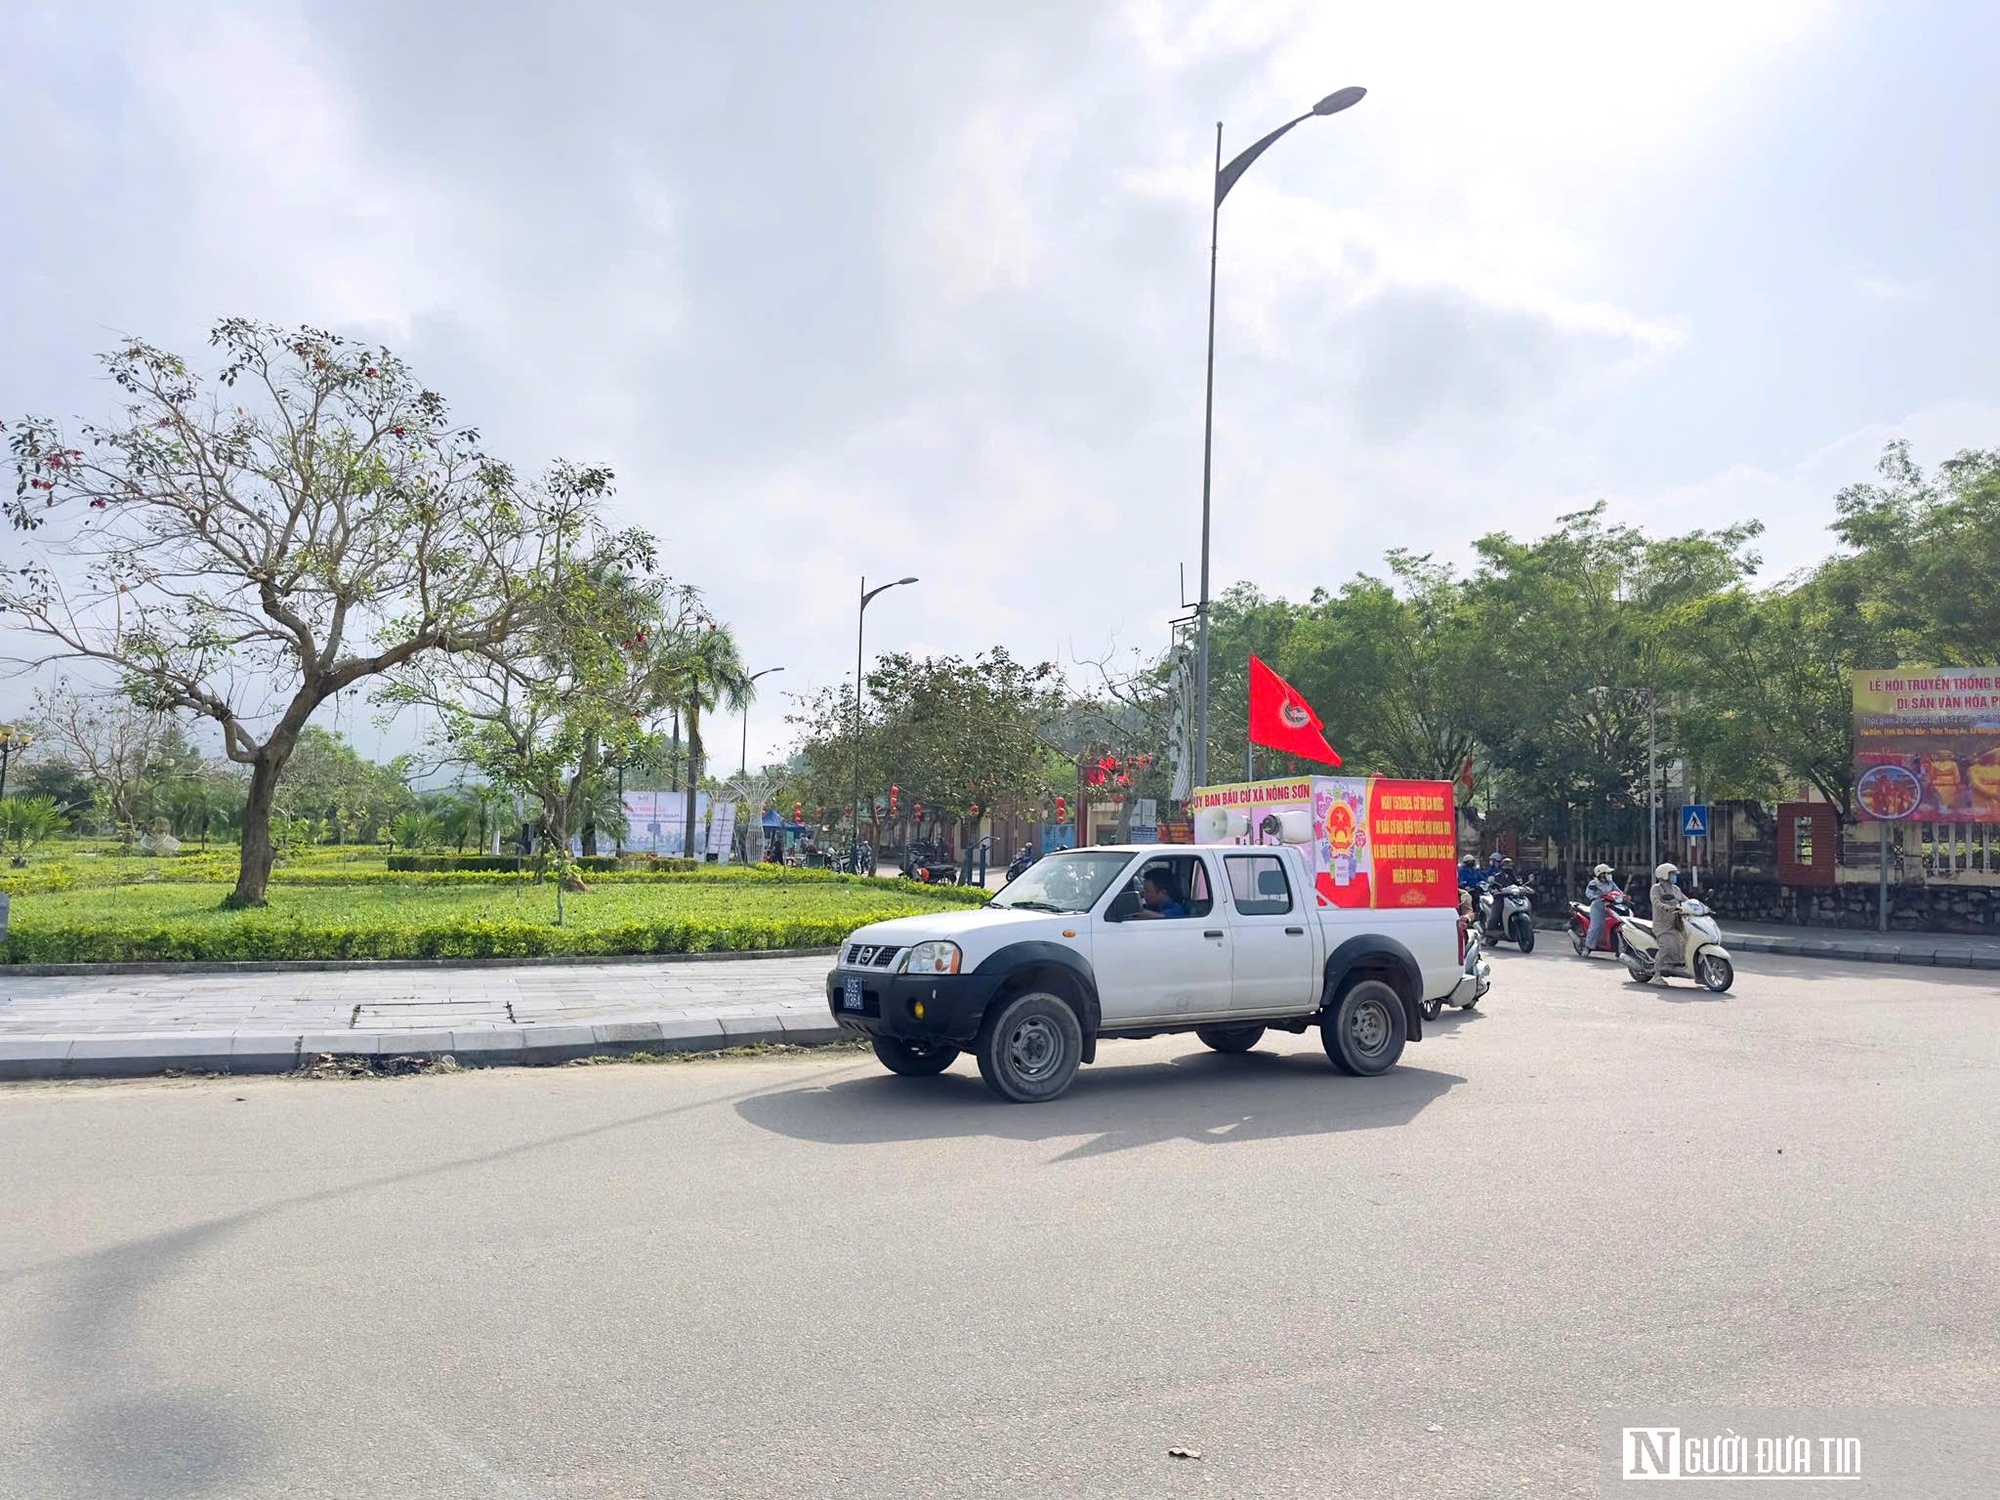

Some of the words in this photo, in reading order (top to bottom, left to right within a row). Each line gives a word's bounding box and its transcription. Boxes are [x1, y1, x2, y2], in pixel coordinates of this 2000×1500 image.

[1885, 679, 1903, 693] HỘI
[1953, 673, 1990, 690] THỐNG
[1897, 698, 1907, 709] DI
[1911, 694, 1934, 709] SẢN
[1205, 793, 1221, 807] BAN
[1222, 788, 1238, 805] BẦU
[1240, 786, 1251, 803] CỬ
[1253, 786, 1264, 802] XÃ
[1266, 784, 1289, 801] NÔNG
[1292, 783, 1310, 799] SƠN
